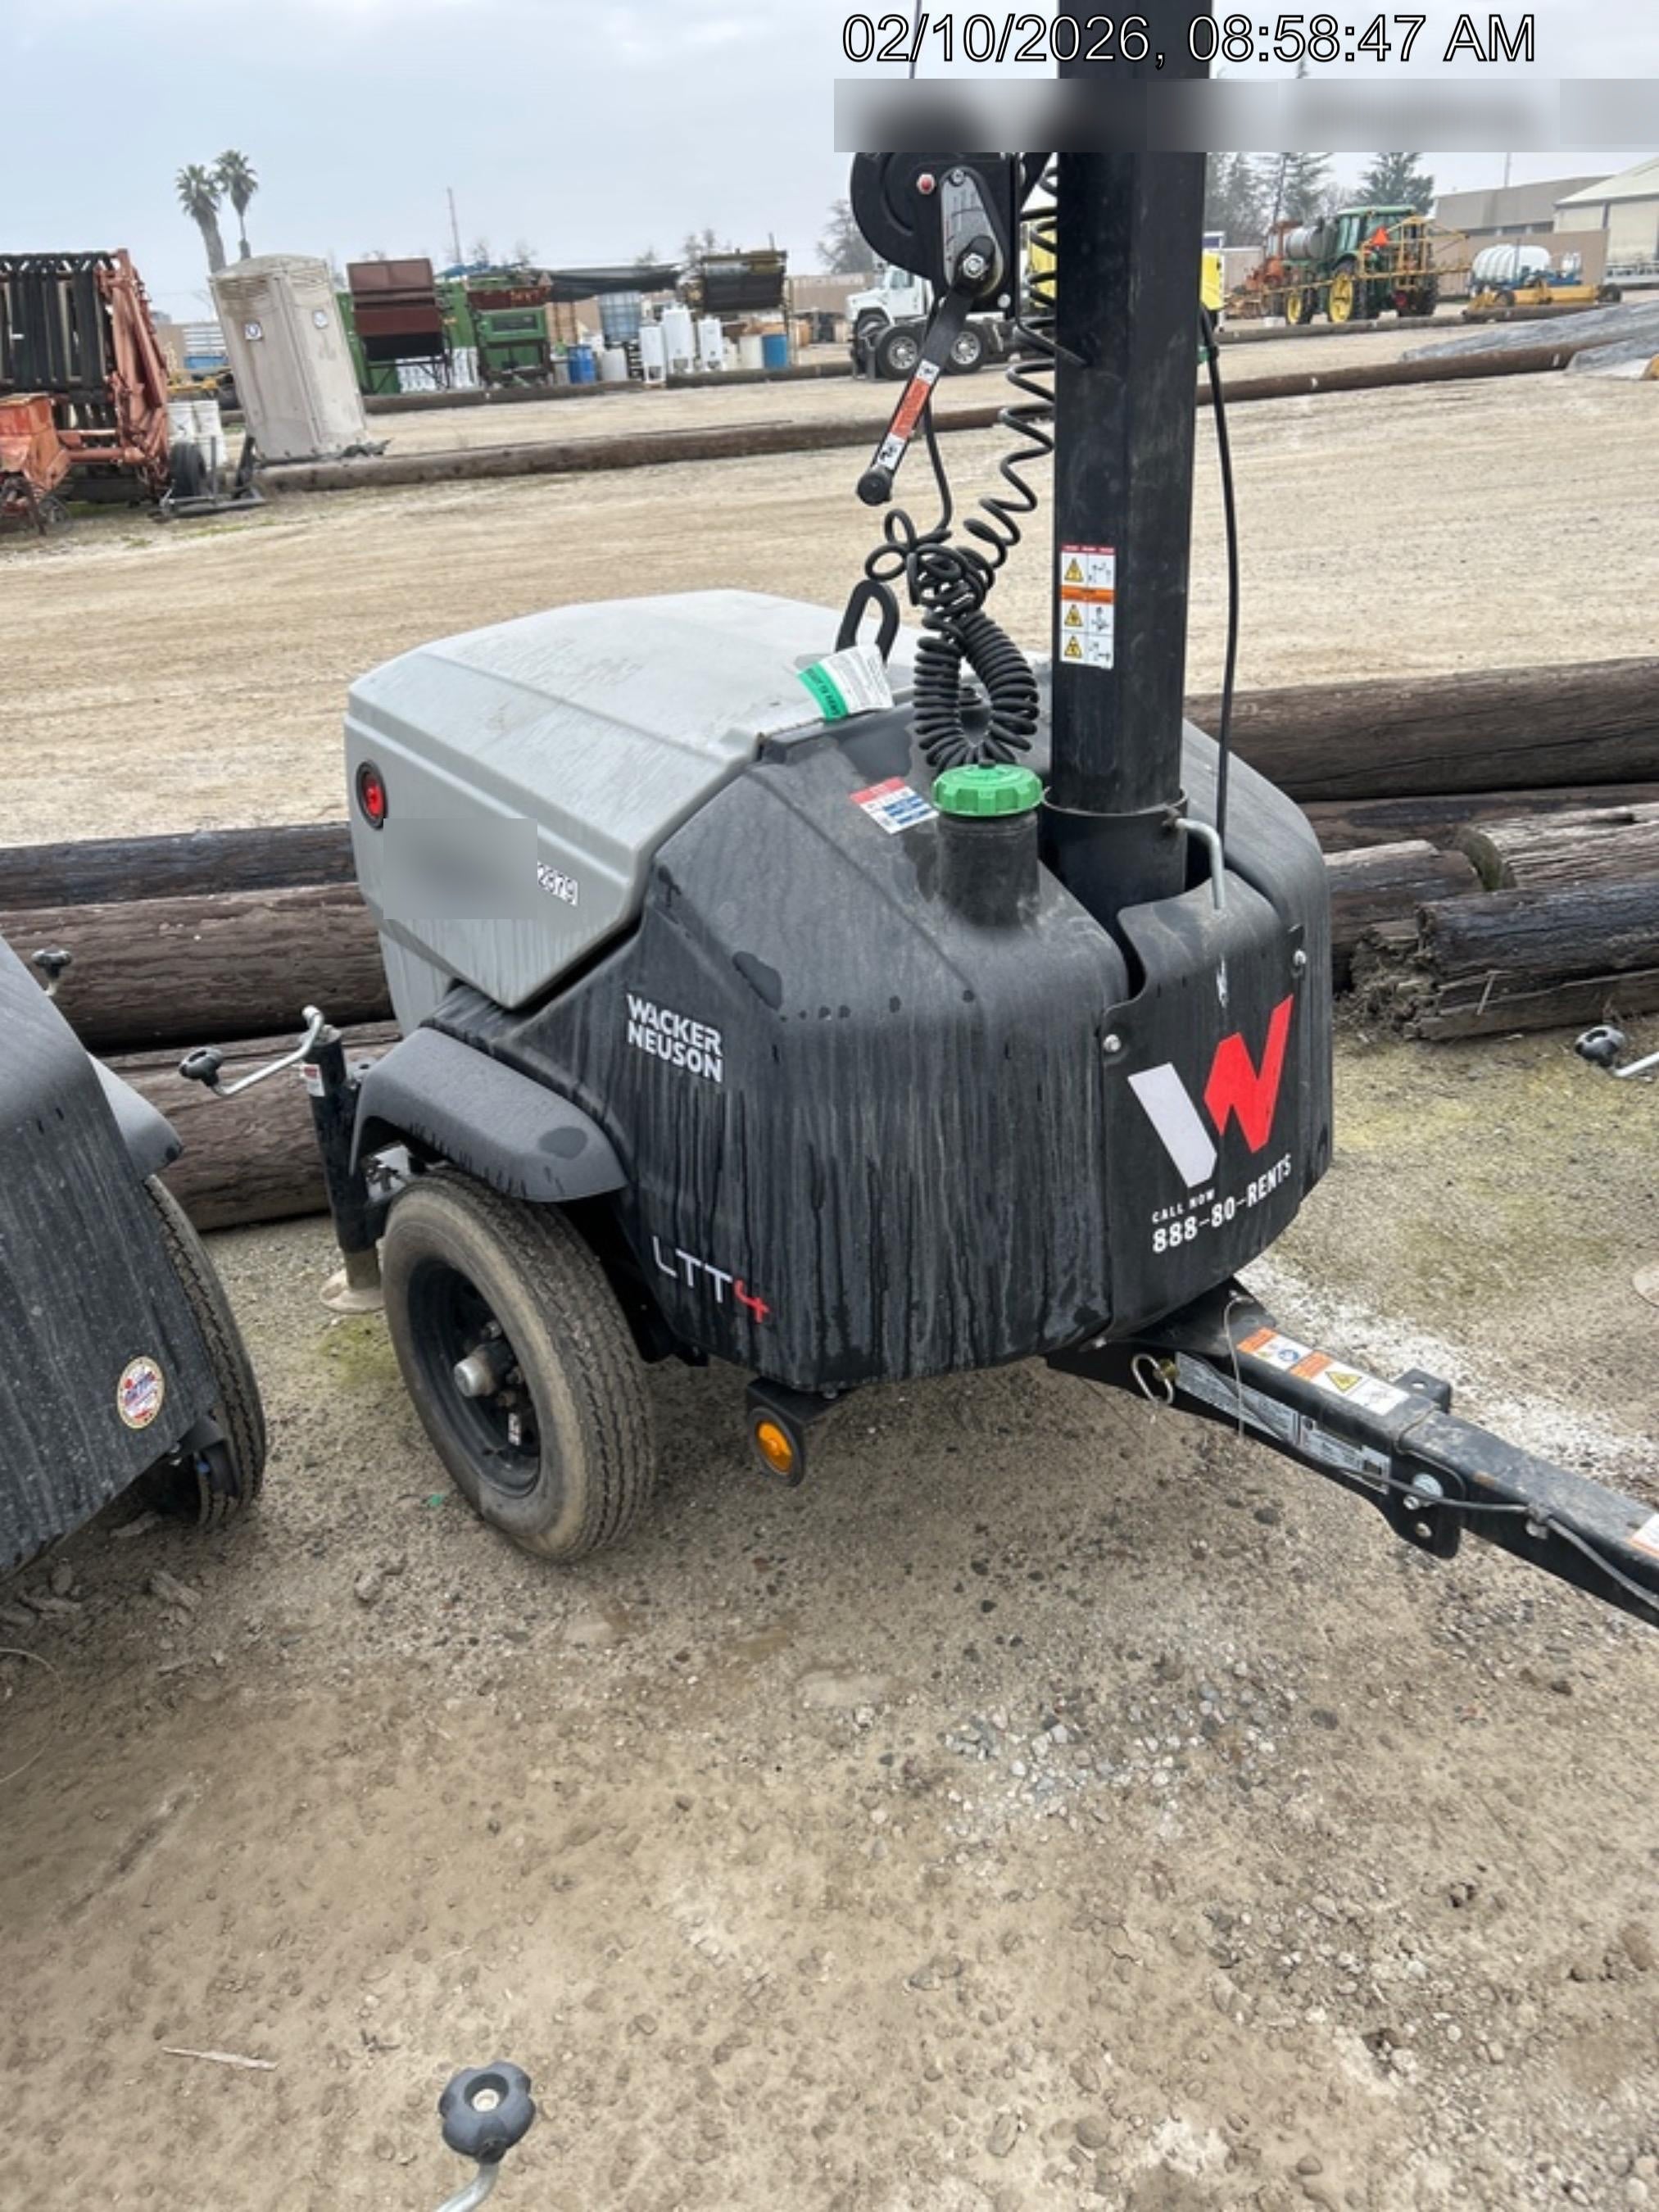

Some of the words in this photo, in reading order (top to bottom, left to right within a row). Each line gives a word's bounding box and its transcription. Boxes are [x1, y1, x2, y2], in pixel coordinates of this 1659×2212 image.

[626, 993, 723, 1057] WACKER
[627, 1019, 723, 1083] NEUSON
[1151, 1202, 1185, 1225] CALL
[1189, 1188, 1216, 1211] NOW
[1152, 1152, 1292, 1254] 888-80-RENTS
[652, 1235, 770, 1325] LTT4
